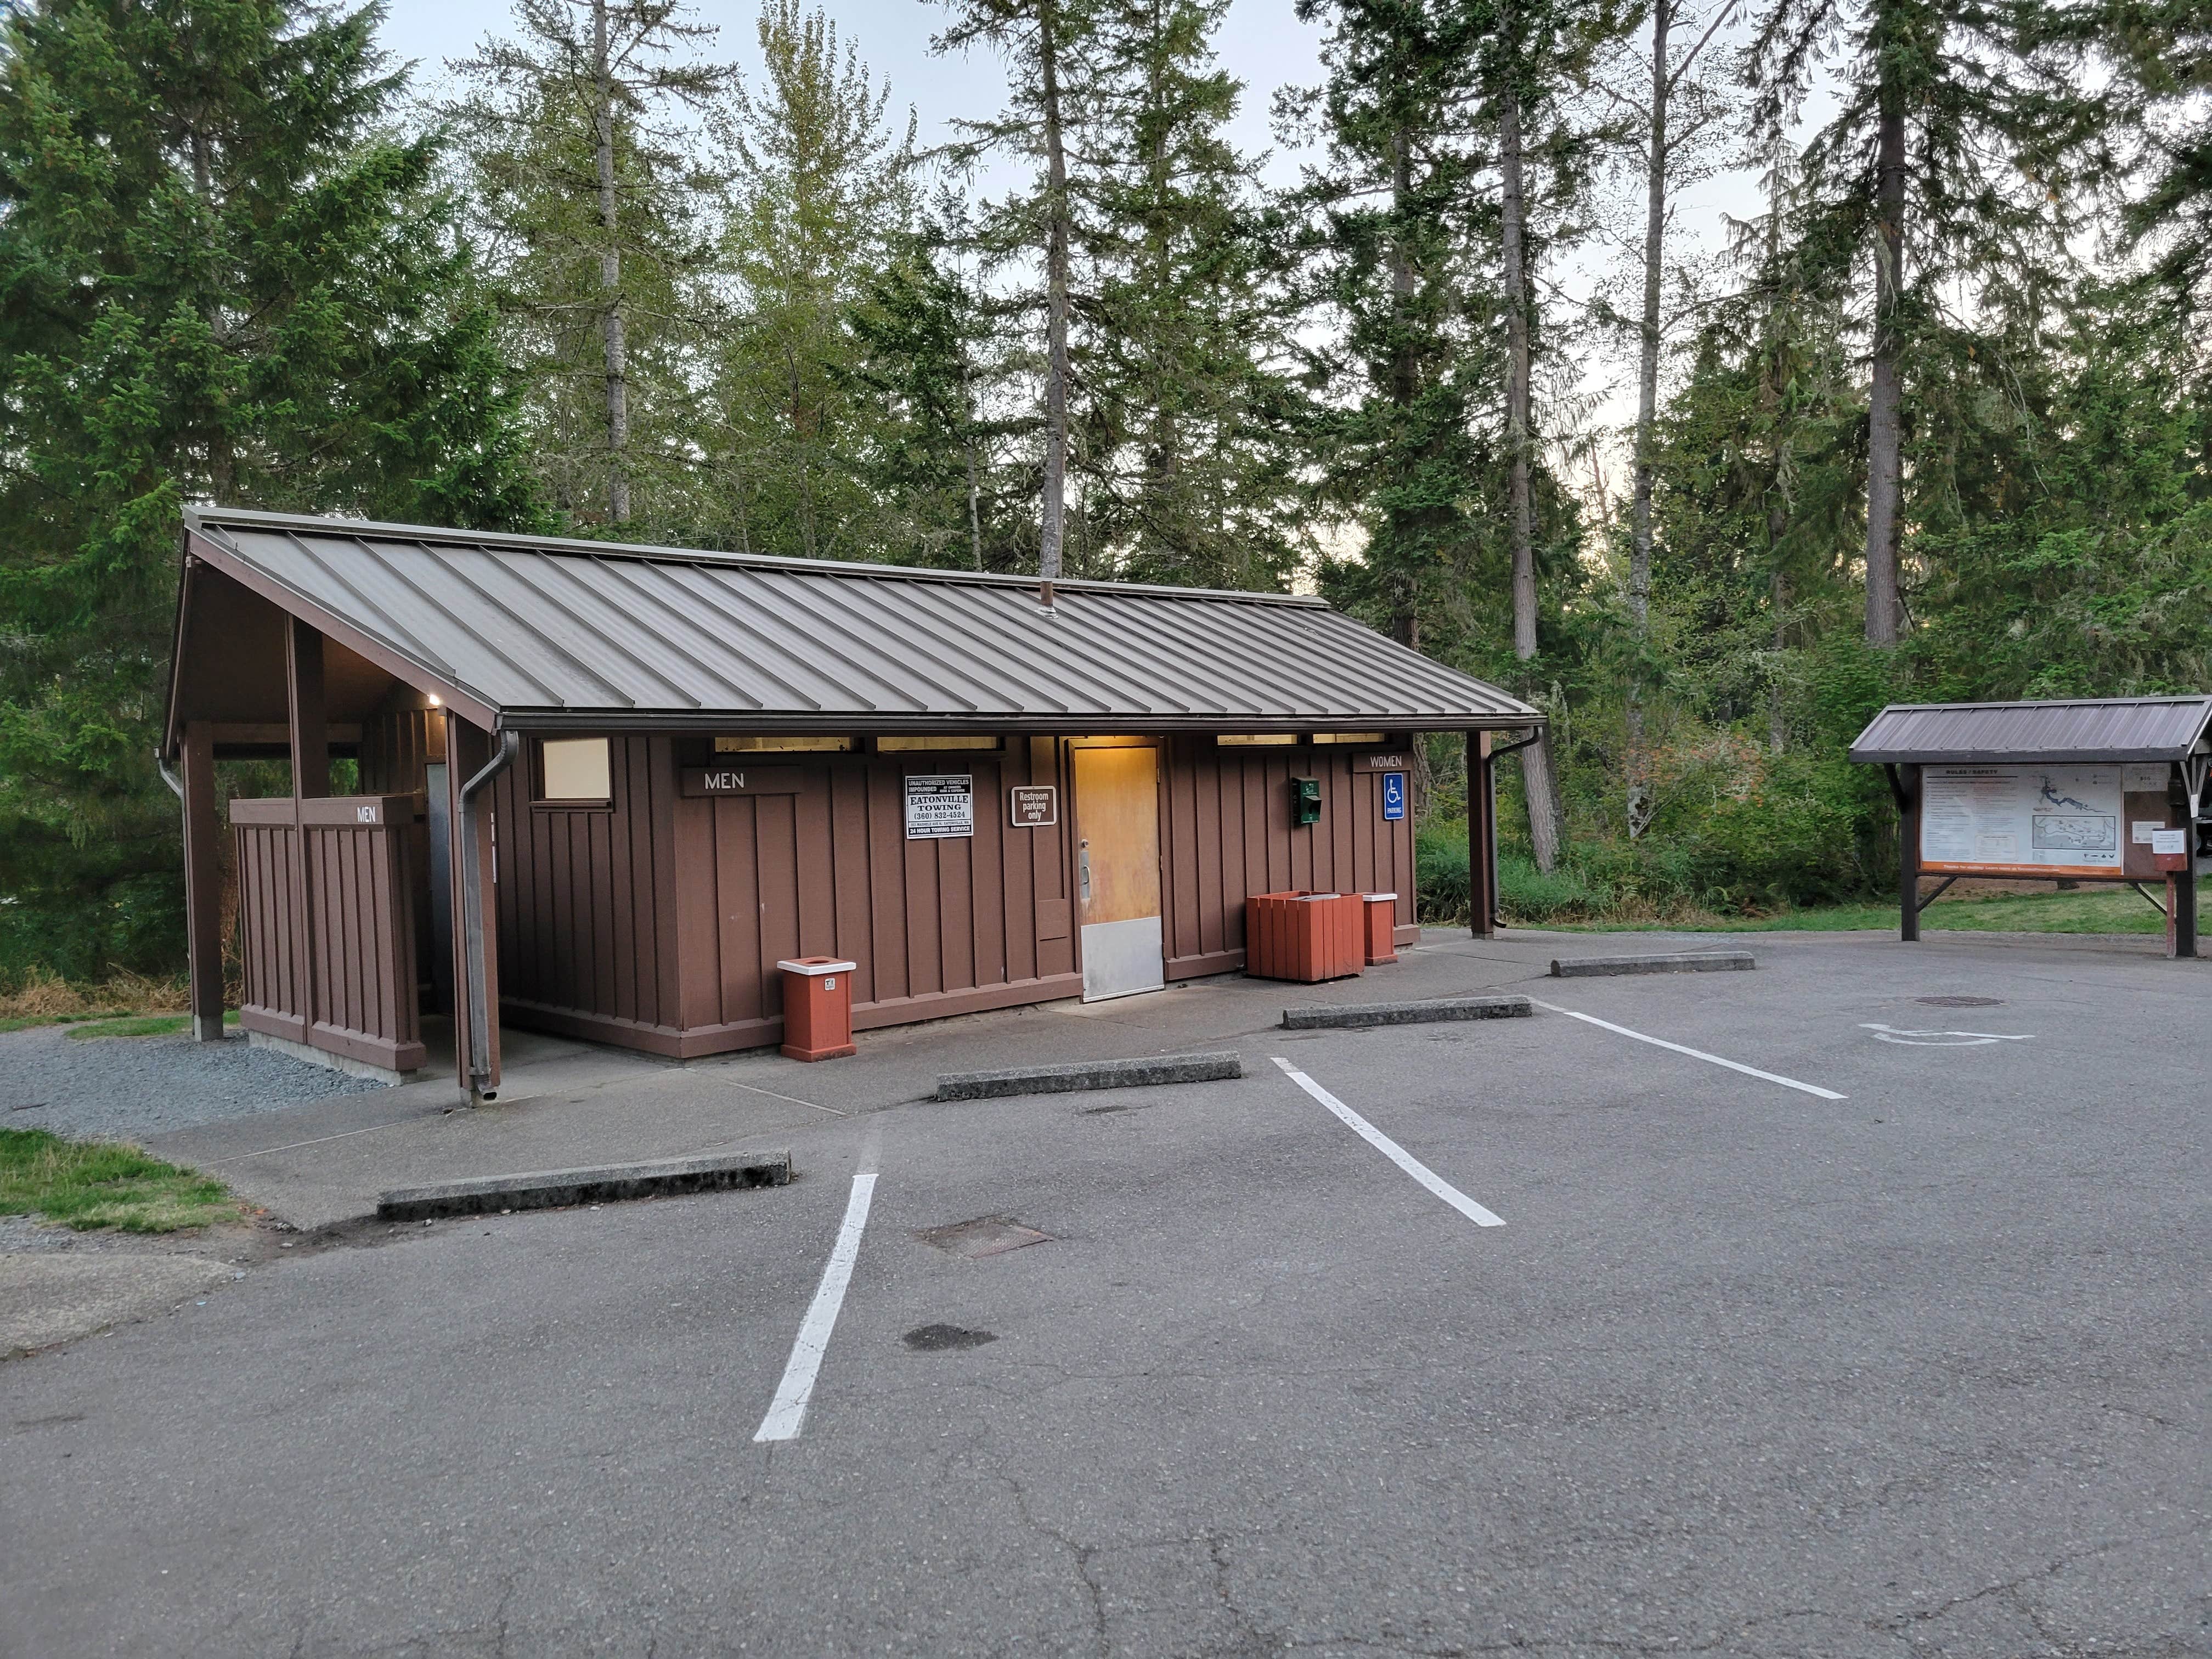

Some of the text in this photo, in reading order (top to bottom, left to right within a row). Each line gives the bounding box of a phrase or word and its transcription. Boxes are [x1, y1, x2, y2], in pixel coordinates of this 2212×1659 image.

[1370, 755, 1402, 768] WOMEN
[705, 773, 744, 789] MEN
[910, 795, 968, 805] EATONVILLE
[1019, 792, 1049, 801] Restroom
[1023, 800, 1046, 812] parking
[357, 806, 376, 822] MEN
[1028, 810, 1042, 822] only
